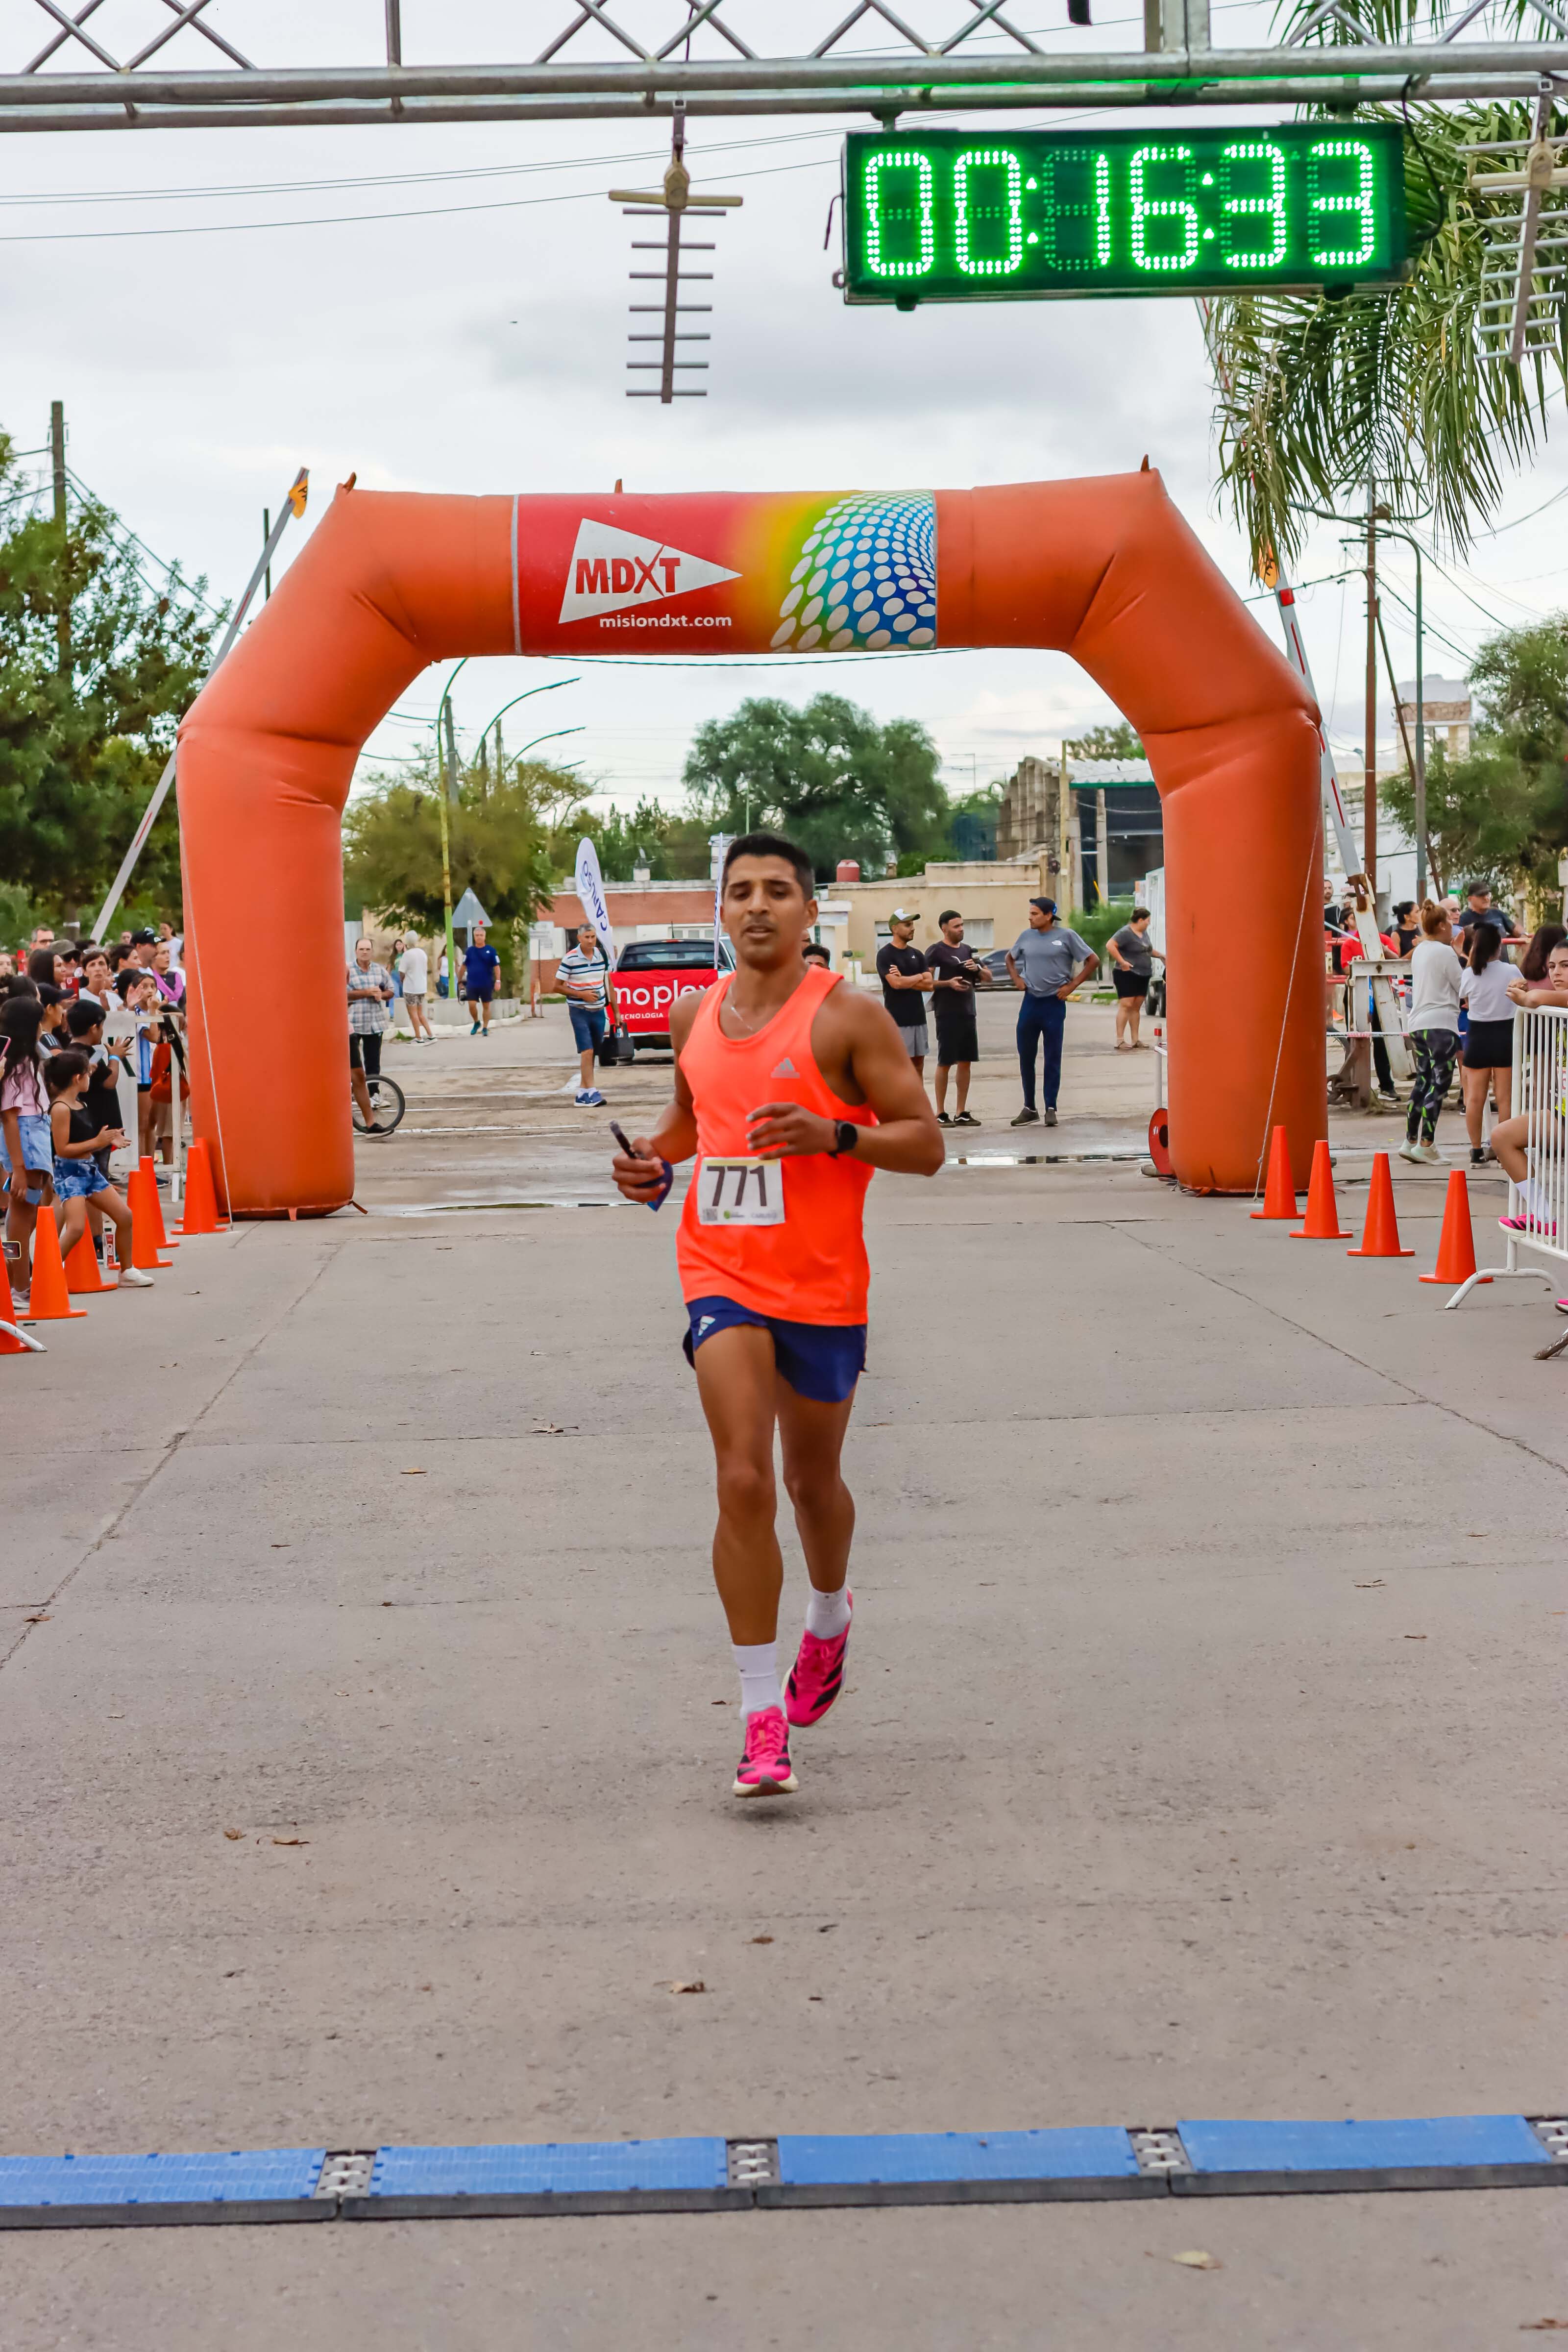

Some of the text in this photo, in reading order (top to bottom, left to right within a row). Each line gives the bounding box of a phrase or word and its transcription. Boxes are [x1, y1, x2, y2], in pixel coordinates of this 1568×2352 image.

[865, 141, 1373, 276] 00:16:33
[575, 545, 681, 597] MDXT
[599, 614, 732, 628] misiondxt.com
[621, 1012, 663, 1021] ECNOLOGIA
[706, 1165, 767, 1206] 771
